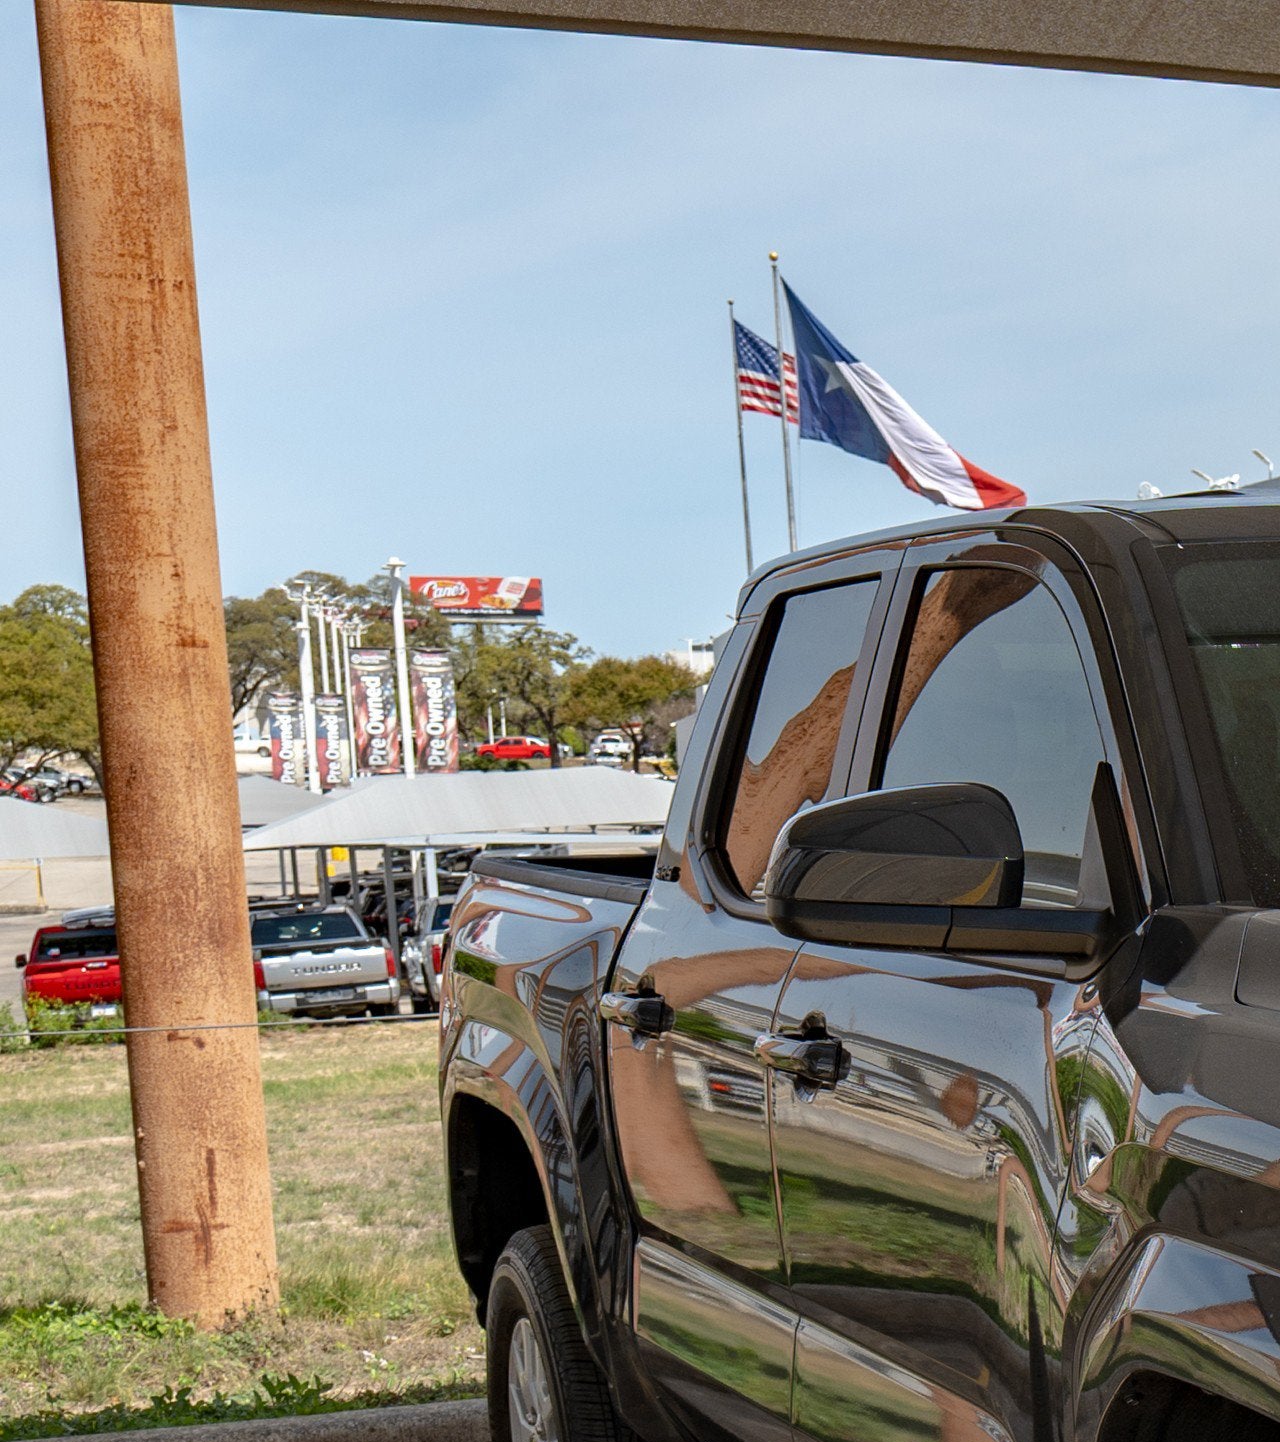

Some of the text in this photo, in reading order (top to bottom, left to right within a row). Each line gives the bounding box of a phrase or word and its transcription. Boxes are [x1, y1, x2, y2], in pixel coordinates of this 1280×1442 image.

[360, 675, 386, 735] Owned
[422, 676, 445, 736] Owned
[279, 714, 295, 760] Owned
[324, 714, 341, 760] Owned
[368, 738, 388, 766] Pre
[427, 738, 447, 766] Pre
[281, 761, 296, 784] Pre
[326, 761, 342, 784] Pre
[290, 963, 361, 976] TUNDRA
